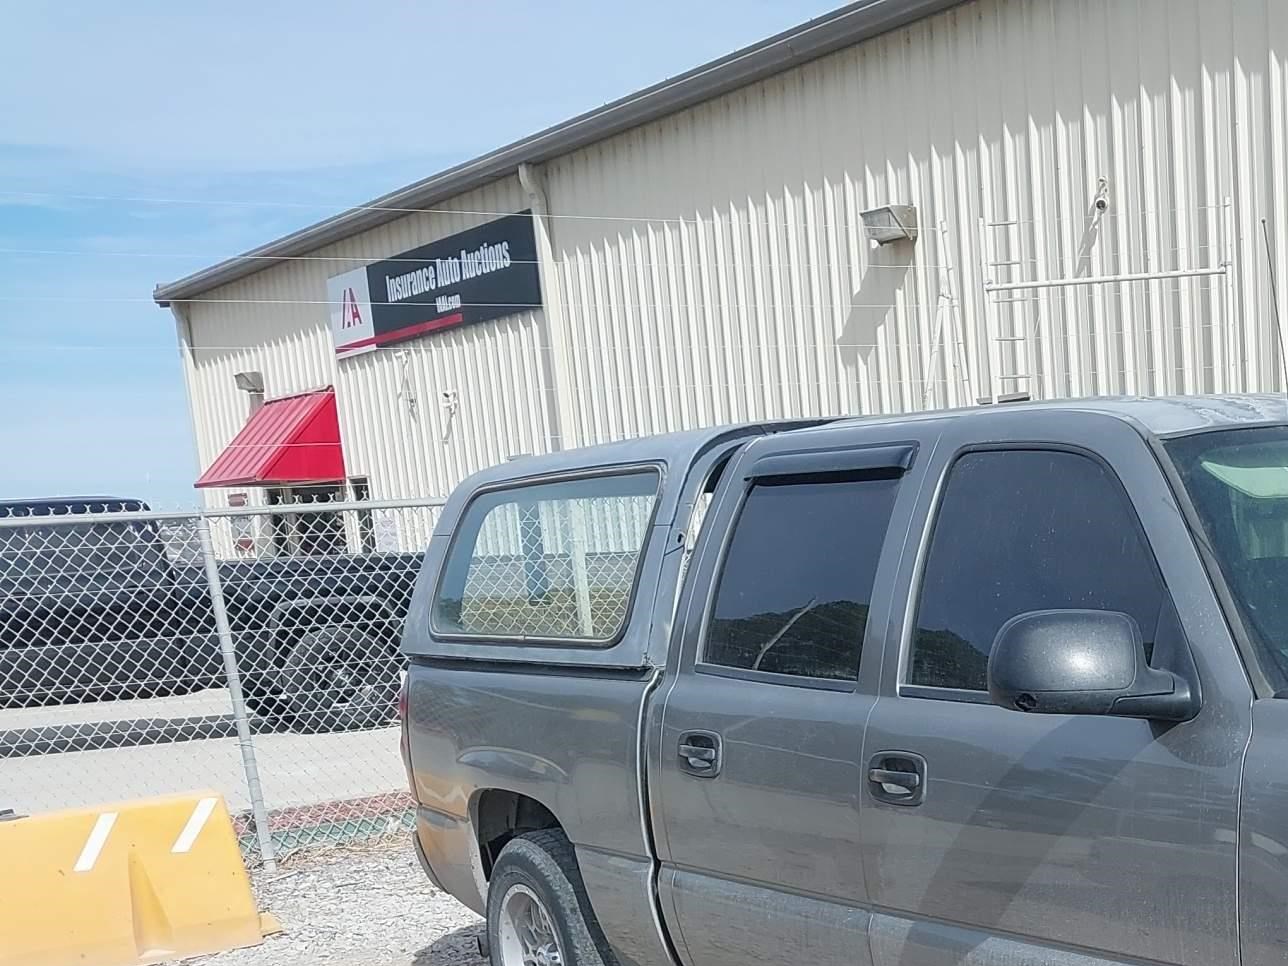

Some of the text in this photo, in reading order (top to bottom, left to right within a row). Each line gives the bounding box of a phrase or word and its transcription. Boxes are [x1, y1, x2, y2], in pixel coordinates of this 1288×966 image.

[385, 240, 511, 302] Insurance Auto Auctions
